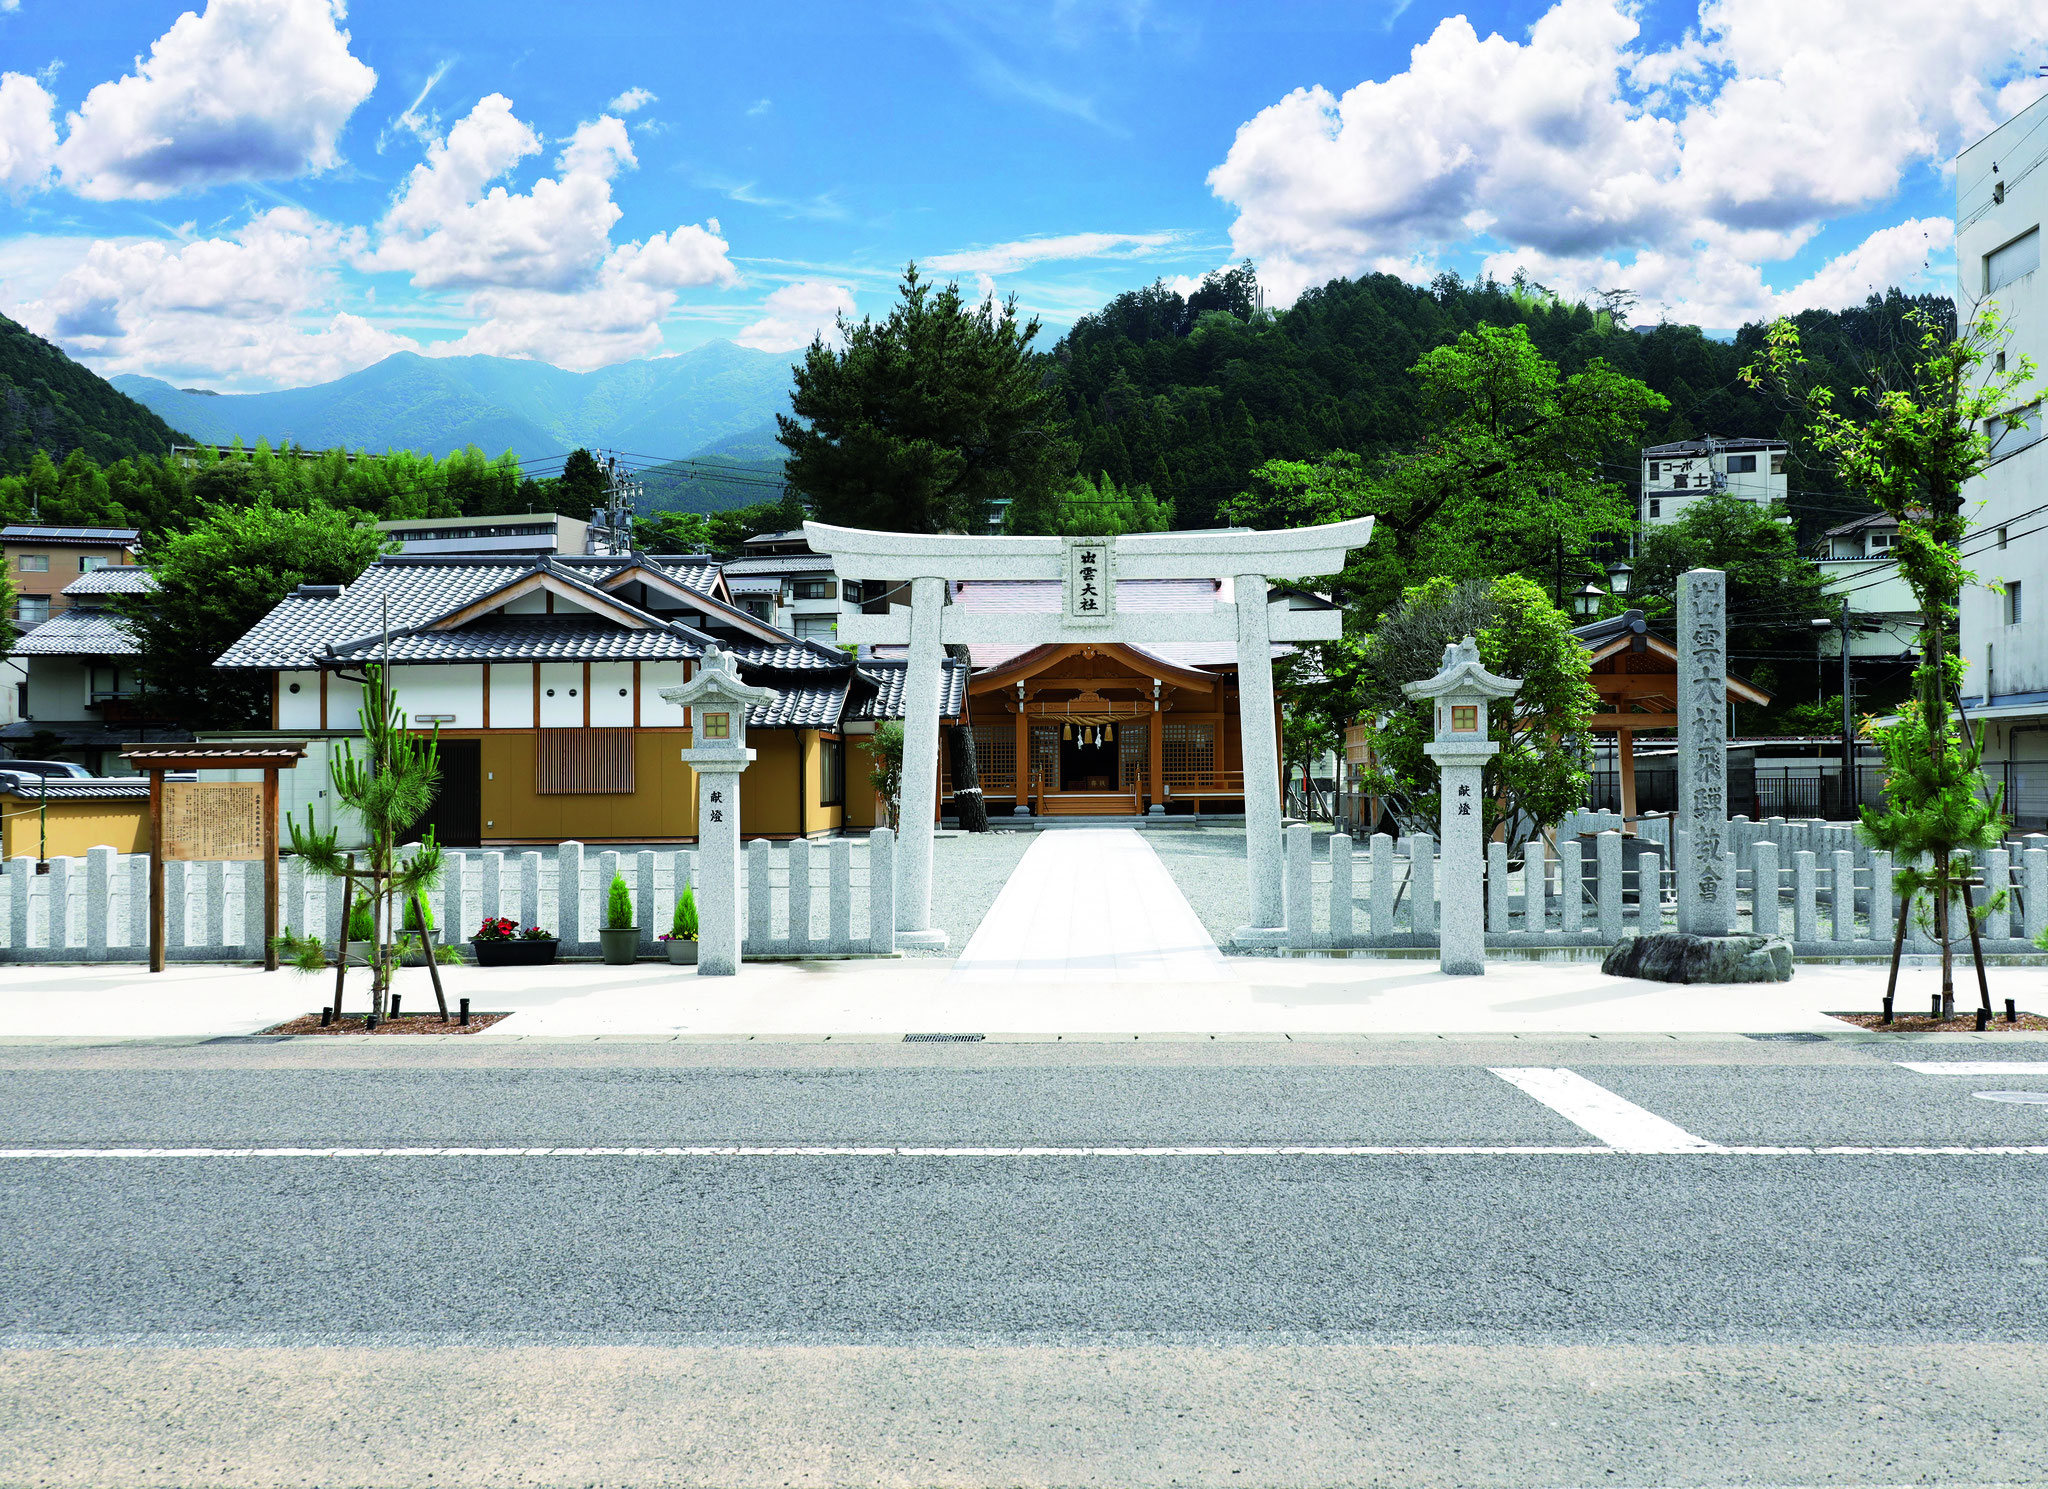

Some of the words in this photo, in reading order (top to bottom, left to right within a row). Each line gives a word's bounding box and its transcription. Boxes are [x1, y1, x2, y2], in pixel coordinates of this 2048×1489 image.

[1662, 460, 1693, 472] コーポ
[1673, 473, 1708, 489] 富士
[1079, 551, 1099, 611] 出雲大社
[710, 790, 723, 823] 献燈
[1458, 784, 1471, 816] 献燈
